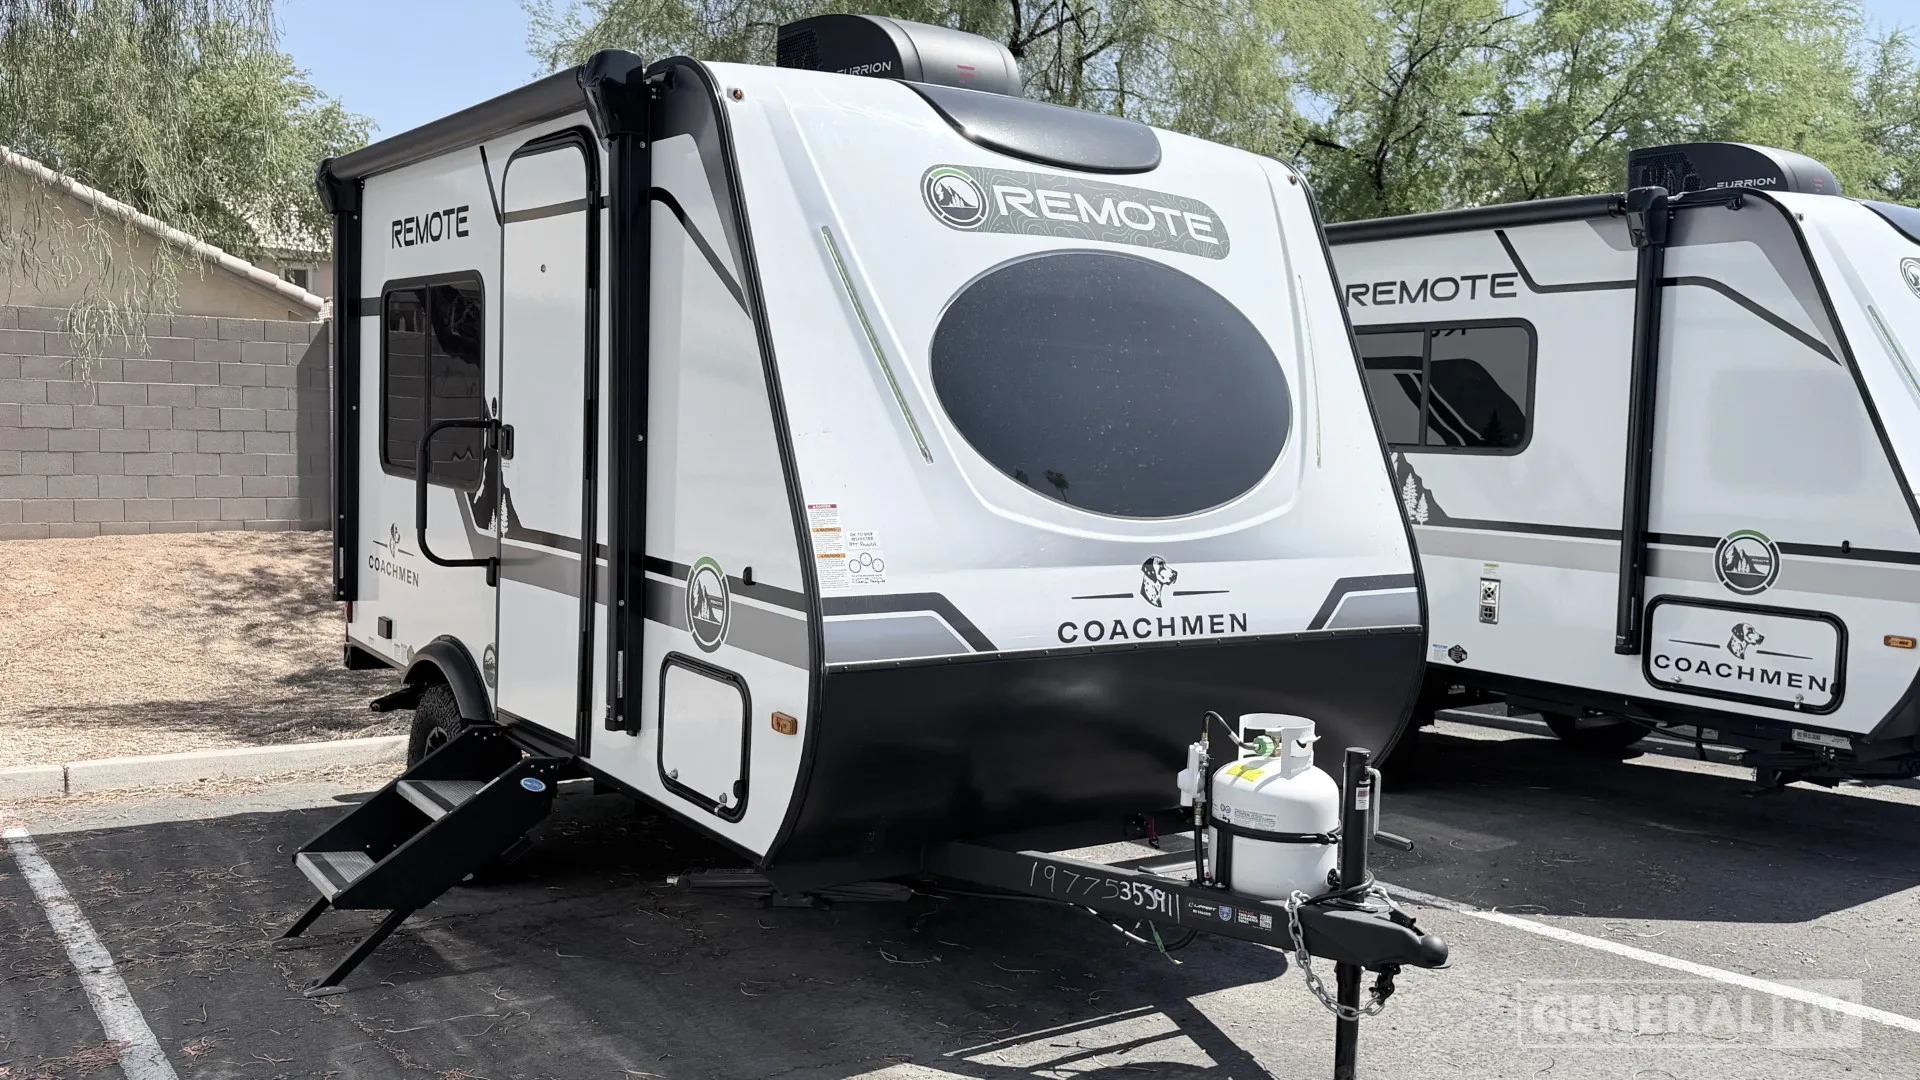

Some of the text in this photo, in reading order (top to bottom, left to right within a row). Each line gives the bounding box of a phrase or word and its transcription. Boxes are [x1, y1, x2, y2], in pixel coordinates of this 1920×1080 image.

[391, 204, 470, 249] REMOTE
[992, 184, 1219, 245] REMOTE
[1345, 272, 1519, 307] REMOTE
[368, 555, 419, 587] COACHMEN
[1057, 612, 1248, 644] COACHMEN
[1653, 654, 1828, 693] COACHMEN
